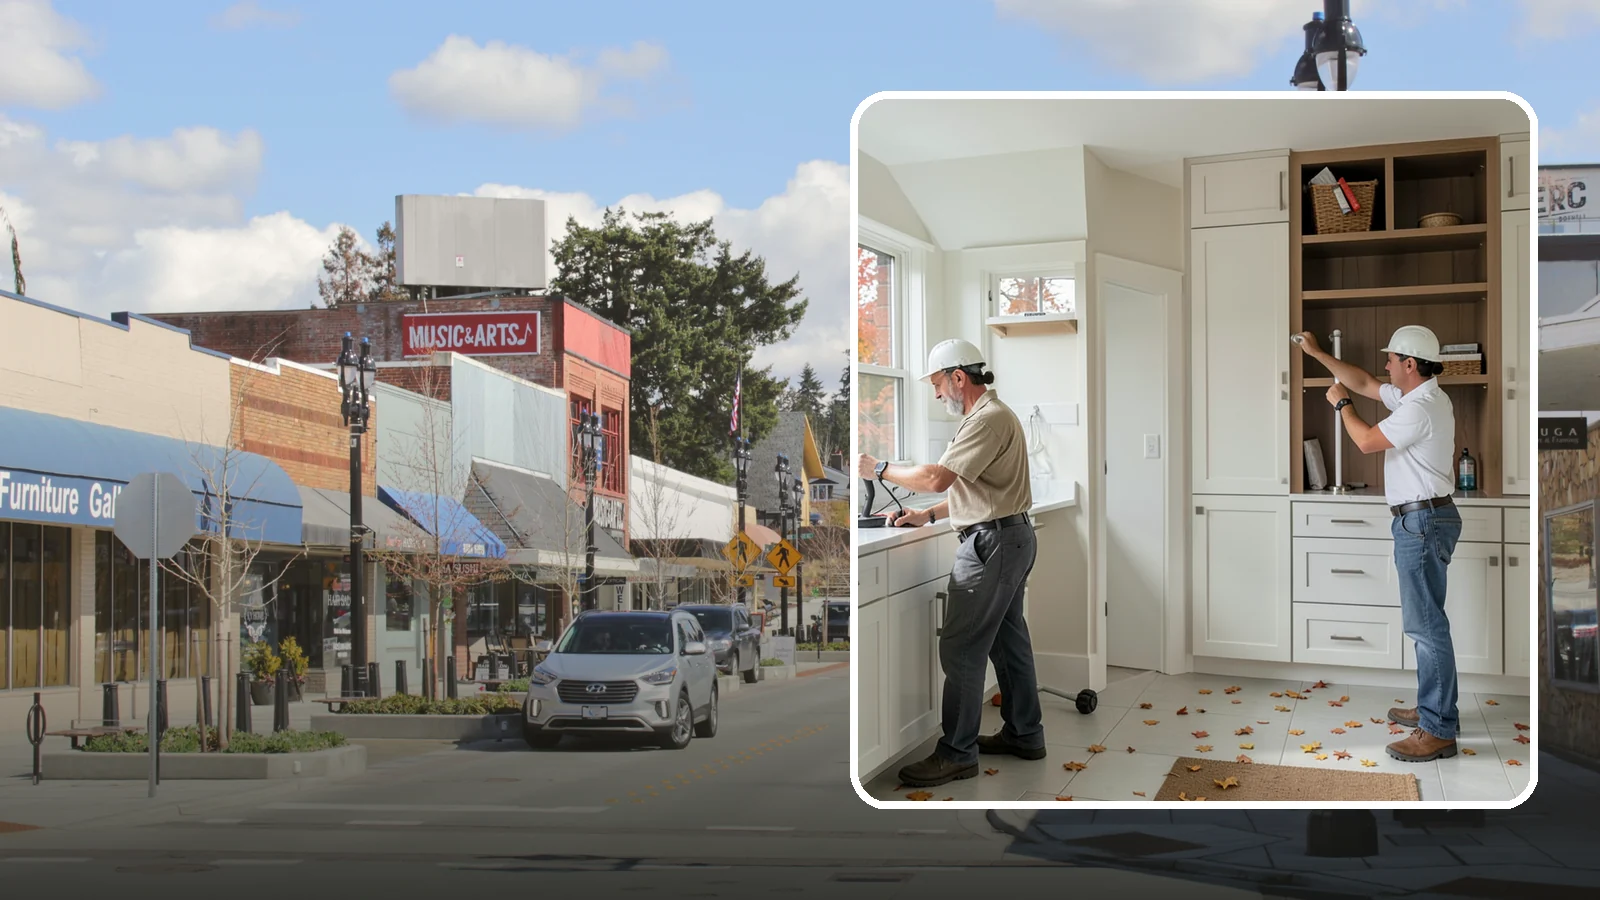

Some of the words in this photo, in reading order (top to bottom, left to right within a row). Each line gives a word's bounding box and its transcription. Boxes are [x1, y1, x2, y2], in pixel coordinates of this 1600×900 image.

[1538, 181, 1586, 213] ERC
[409, 323, 519, 348] MUSIC&ARTS
[1540, 427, 1577, 436] UGA
[0, 471, 79, 515] Furniture
[89, 482, 121, 519] Gal
[453, 563, 479, 574] SUSHI
